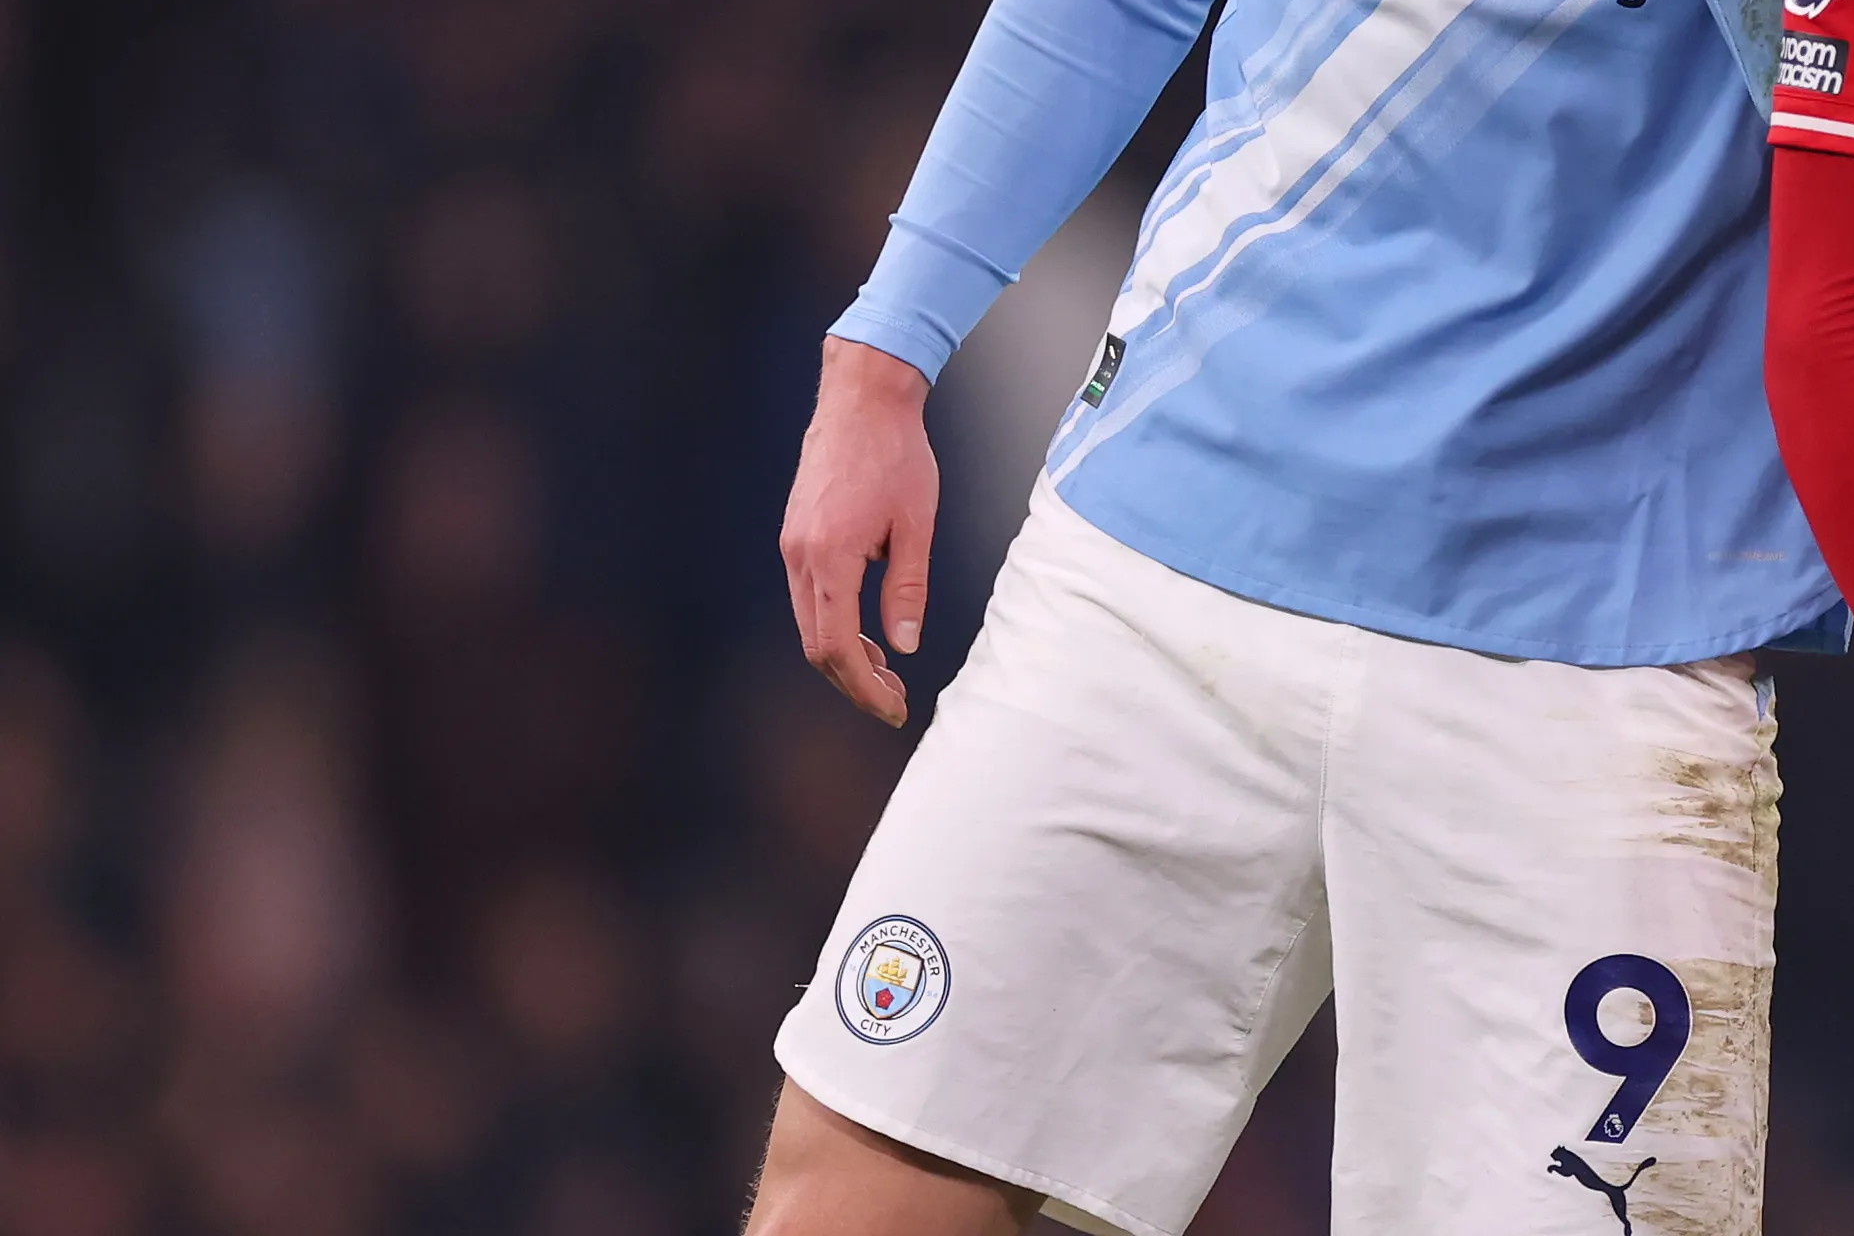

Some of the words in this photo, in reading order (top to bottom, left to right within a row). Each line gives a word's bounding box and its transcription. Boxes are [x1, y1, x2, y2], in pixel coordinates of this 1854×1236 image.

[860, 926, 939, 976] MANCHESTER
[860, 1019, 892, 1037] CITY
[1564, 953, 1693, 1144] 9
